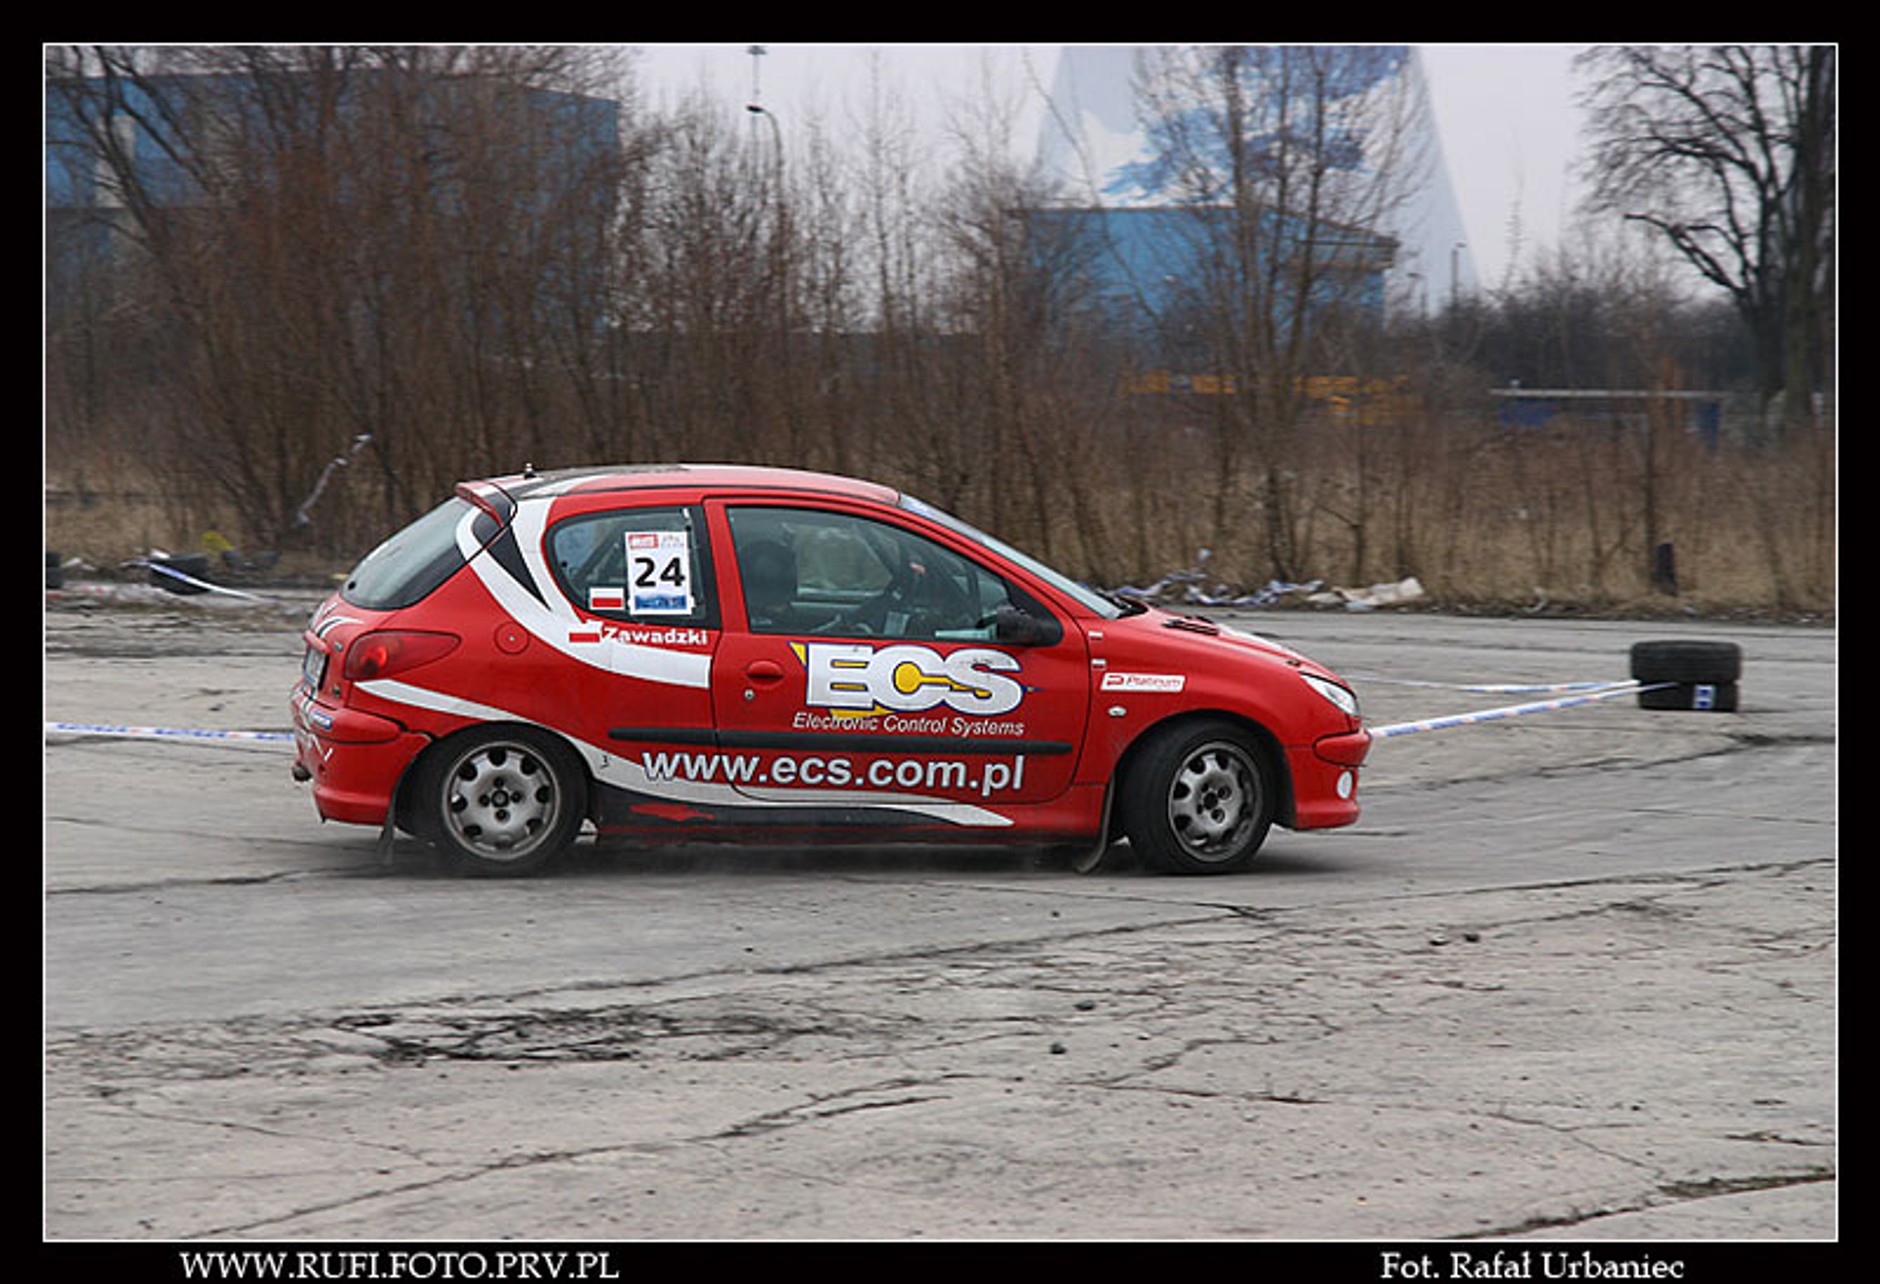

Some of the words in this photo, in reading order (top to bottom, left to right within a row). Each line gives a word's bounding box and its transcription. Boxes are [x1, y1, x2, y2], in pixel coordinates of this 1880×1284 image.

[634, 556, 686, 588] 24
[603, 626, 708, 646] Zawadzki
[806, 643, 1022, 716] ECS
[792, 711, 878, 730] Electronic
[883, 714, 947, 733] Control
[951, 716, 1025, 738] Systems
[642, 751, 1025, 796] www.ecs.com.pl
